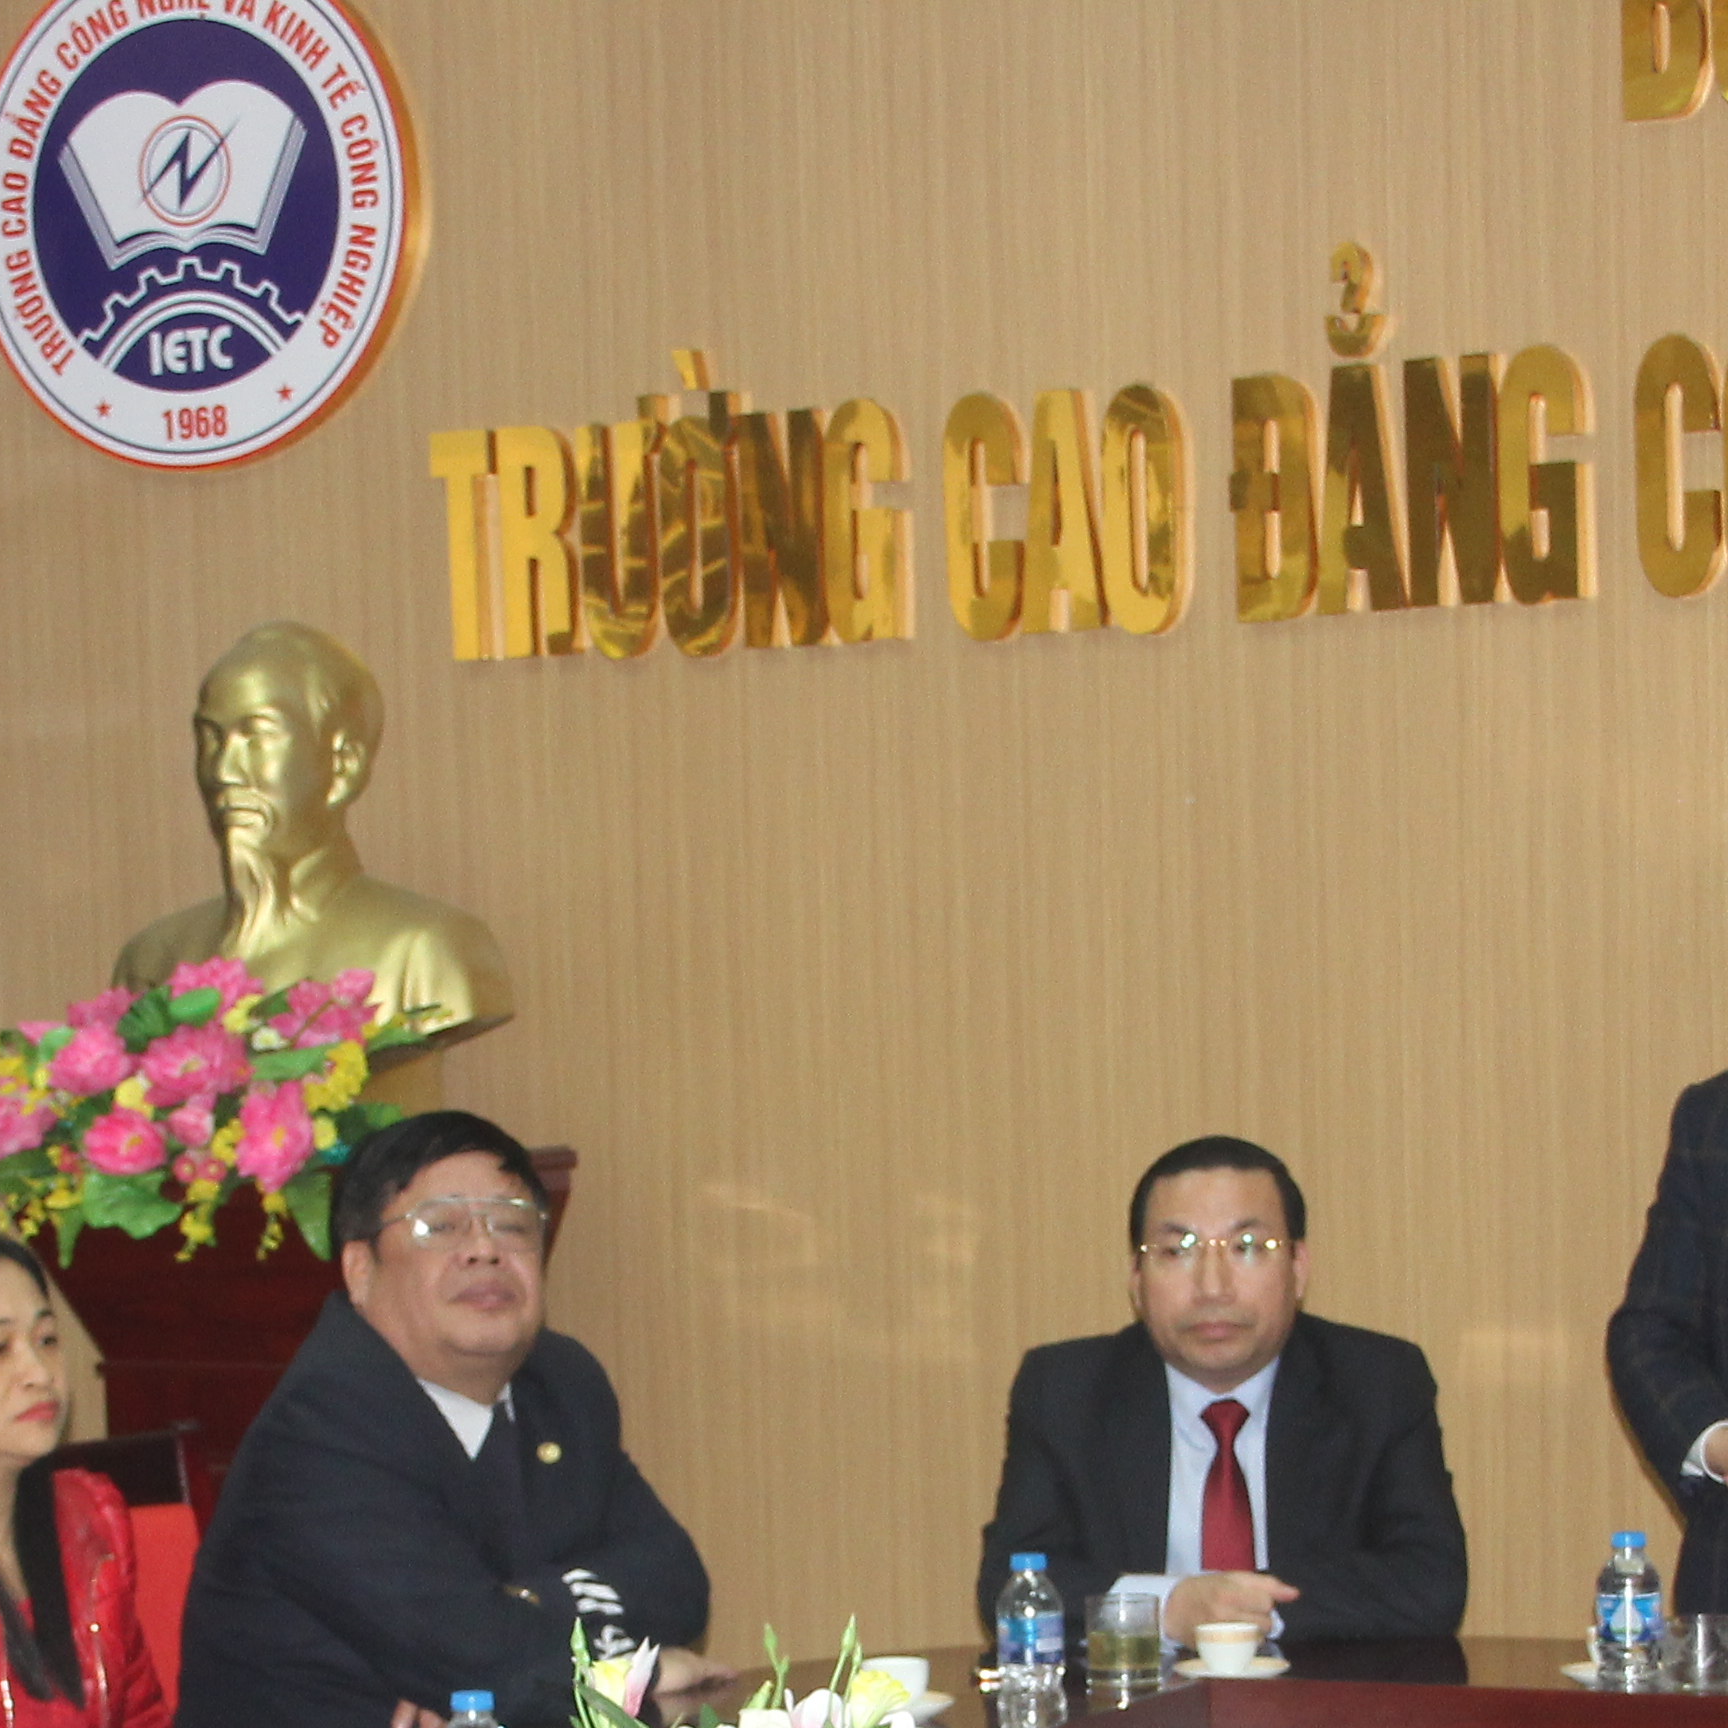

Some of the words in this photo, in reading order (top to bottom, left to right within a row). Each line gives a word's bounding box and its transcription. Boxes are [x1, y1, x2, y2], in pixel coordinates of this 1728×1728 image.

[57, 0, 129, 70] CÔNG
[263, 3, 331, 72] KINH
[321, 63, 367, 111] TẾ
[340, 113, 380, 210] CÔNG
[1, 172, 29, 238] CAO
[318, 223, 378, 349] NGHIỆP
[148, 324, 235, 377] IETC
[162, 404, 228, 441] 1968
[429, 349, 912, 660] TRƯỜNG
[942, 384, 1186, 642] CAO
[1229, 240, 1594, 624] ĐẲNG
